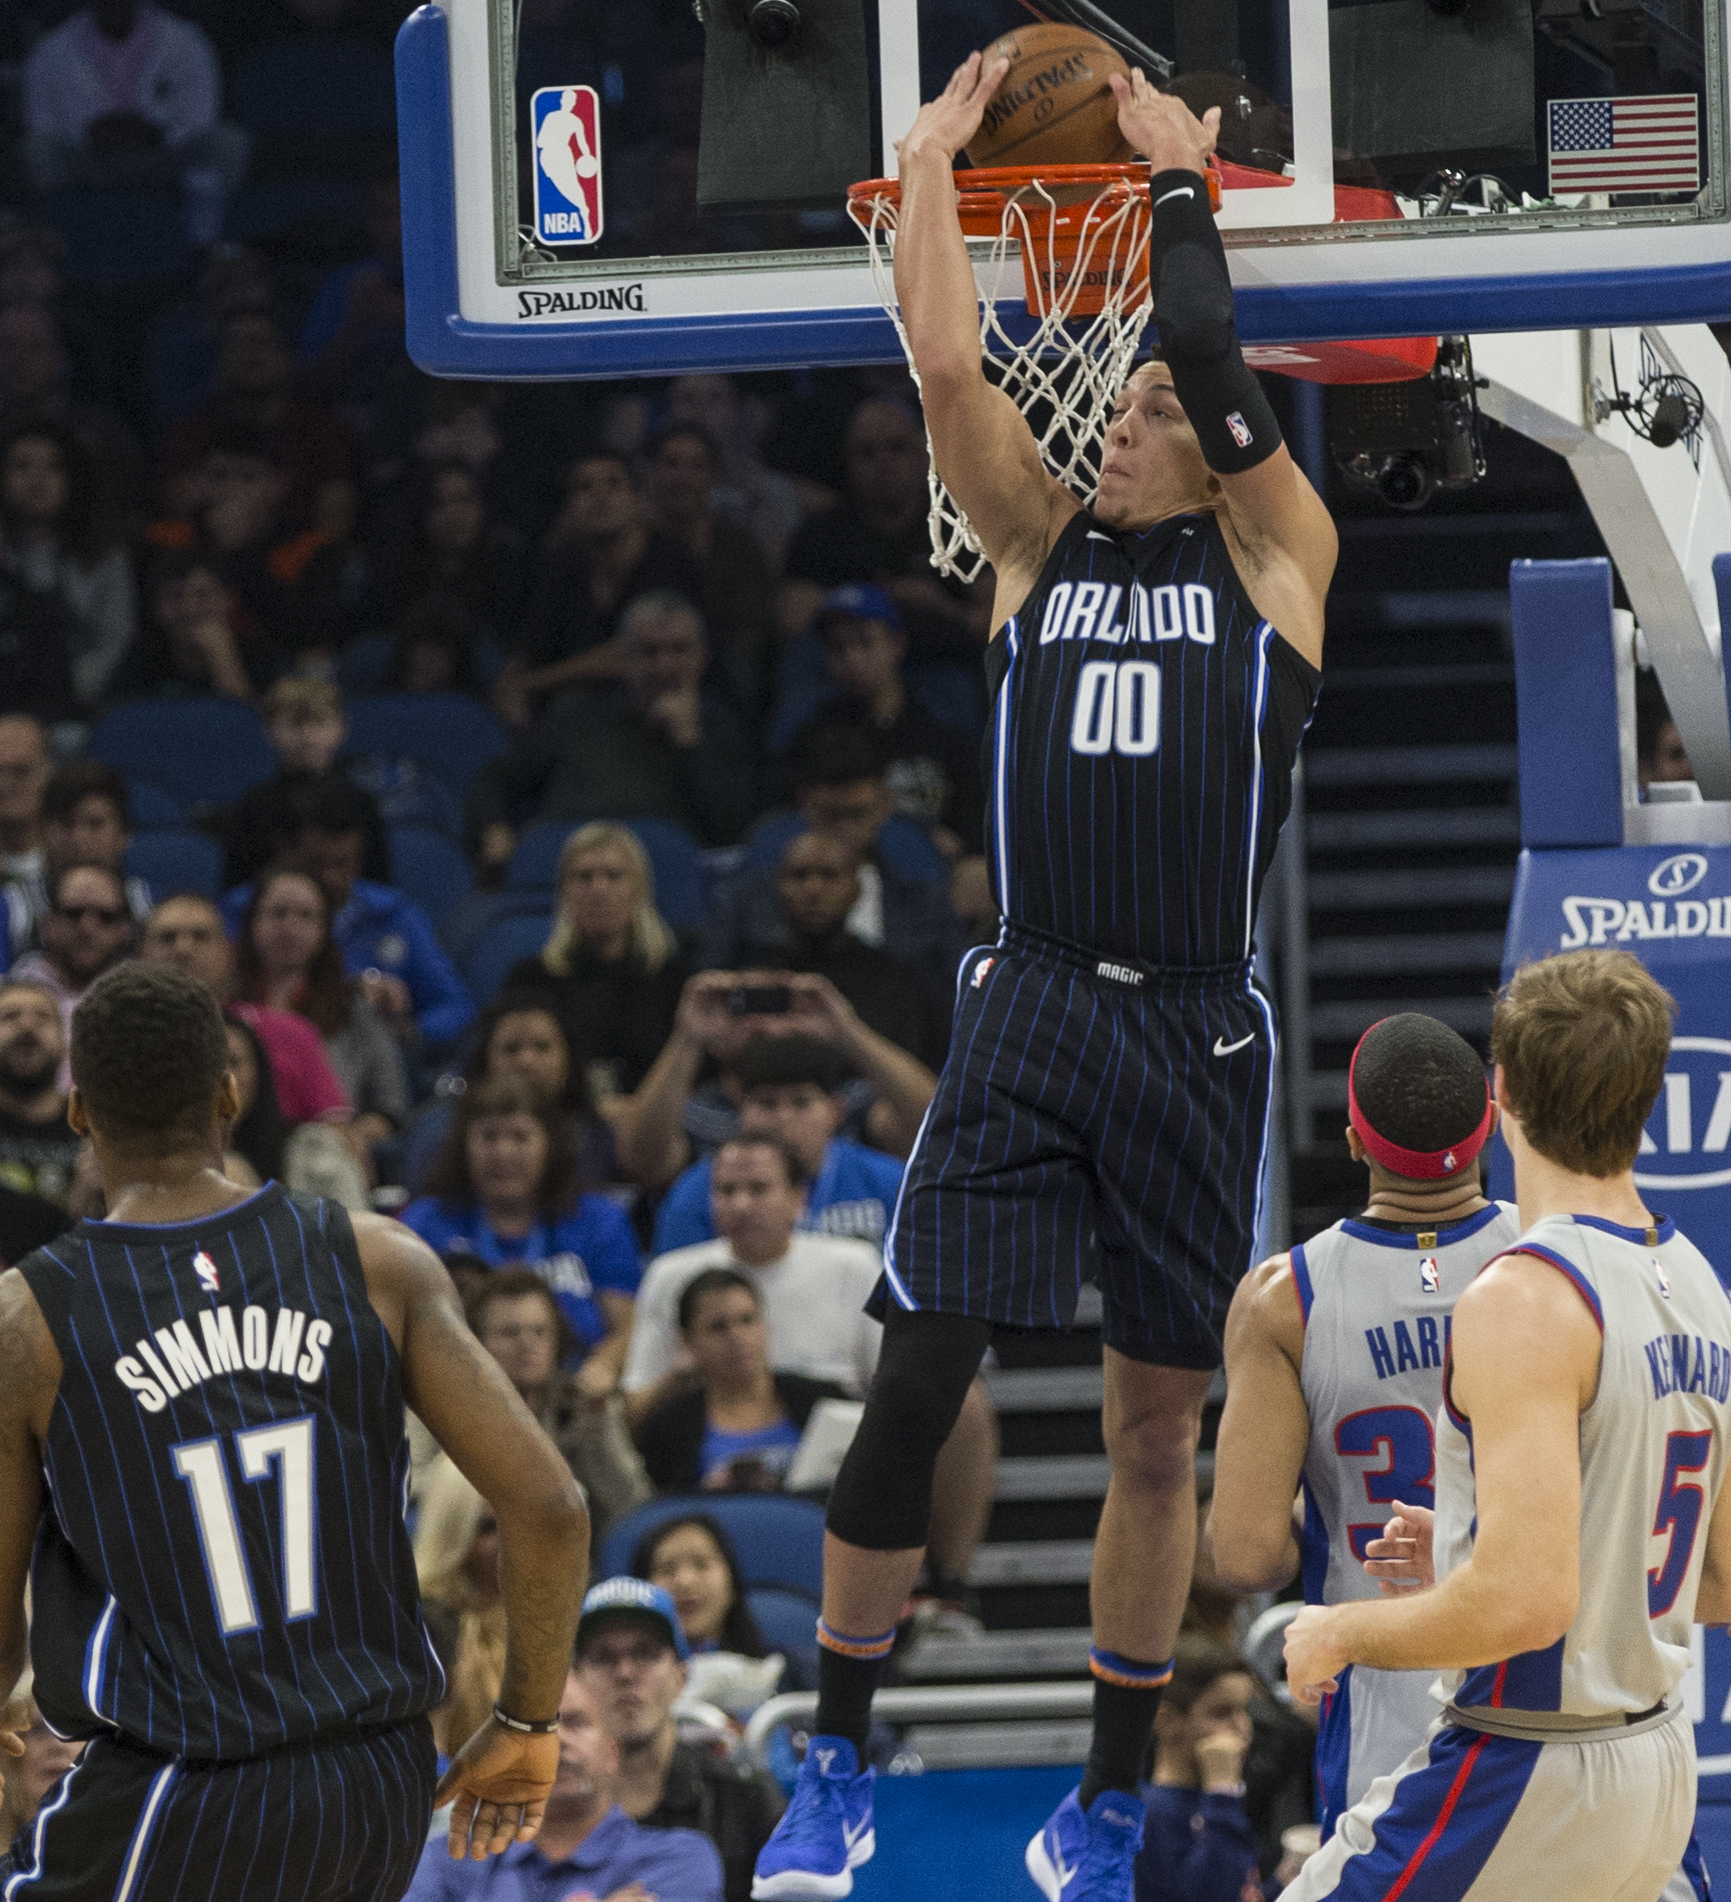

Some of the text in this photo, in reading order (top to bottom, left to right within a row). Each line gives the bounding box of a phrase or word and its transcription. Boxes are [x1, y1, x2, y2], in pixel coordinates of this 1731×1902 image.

[543, 211, 582, 236] NBA
[518, 283, 644, 319] SPALDING
[1039, 580, 1215, 645] ORLDO
[1070, 659, 1162, 757] 00
[1097, 961, 1144, 987] MAGIC
[115, 1305, 333, 1413] SIMMONS
[1644, 1334, 1731, 1405] KENARD
[169, 1413, 318, 1637] 17
[1648, 1429, 1713, 1620] 5
